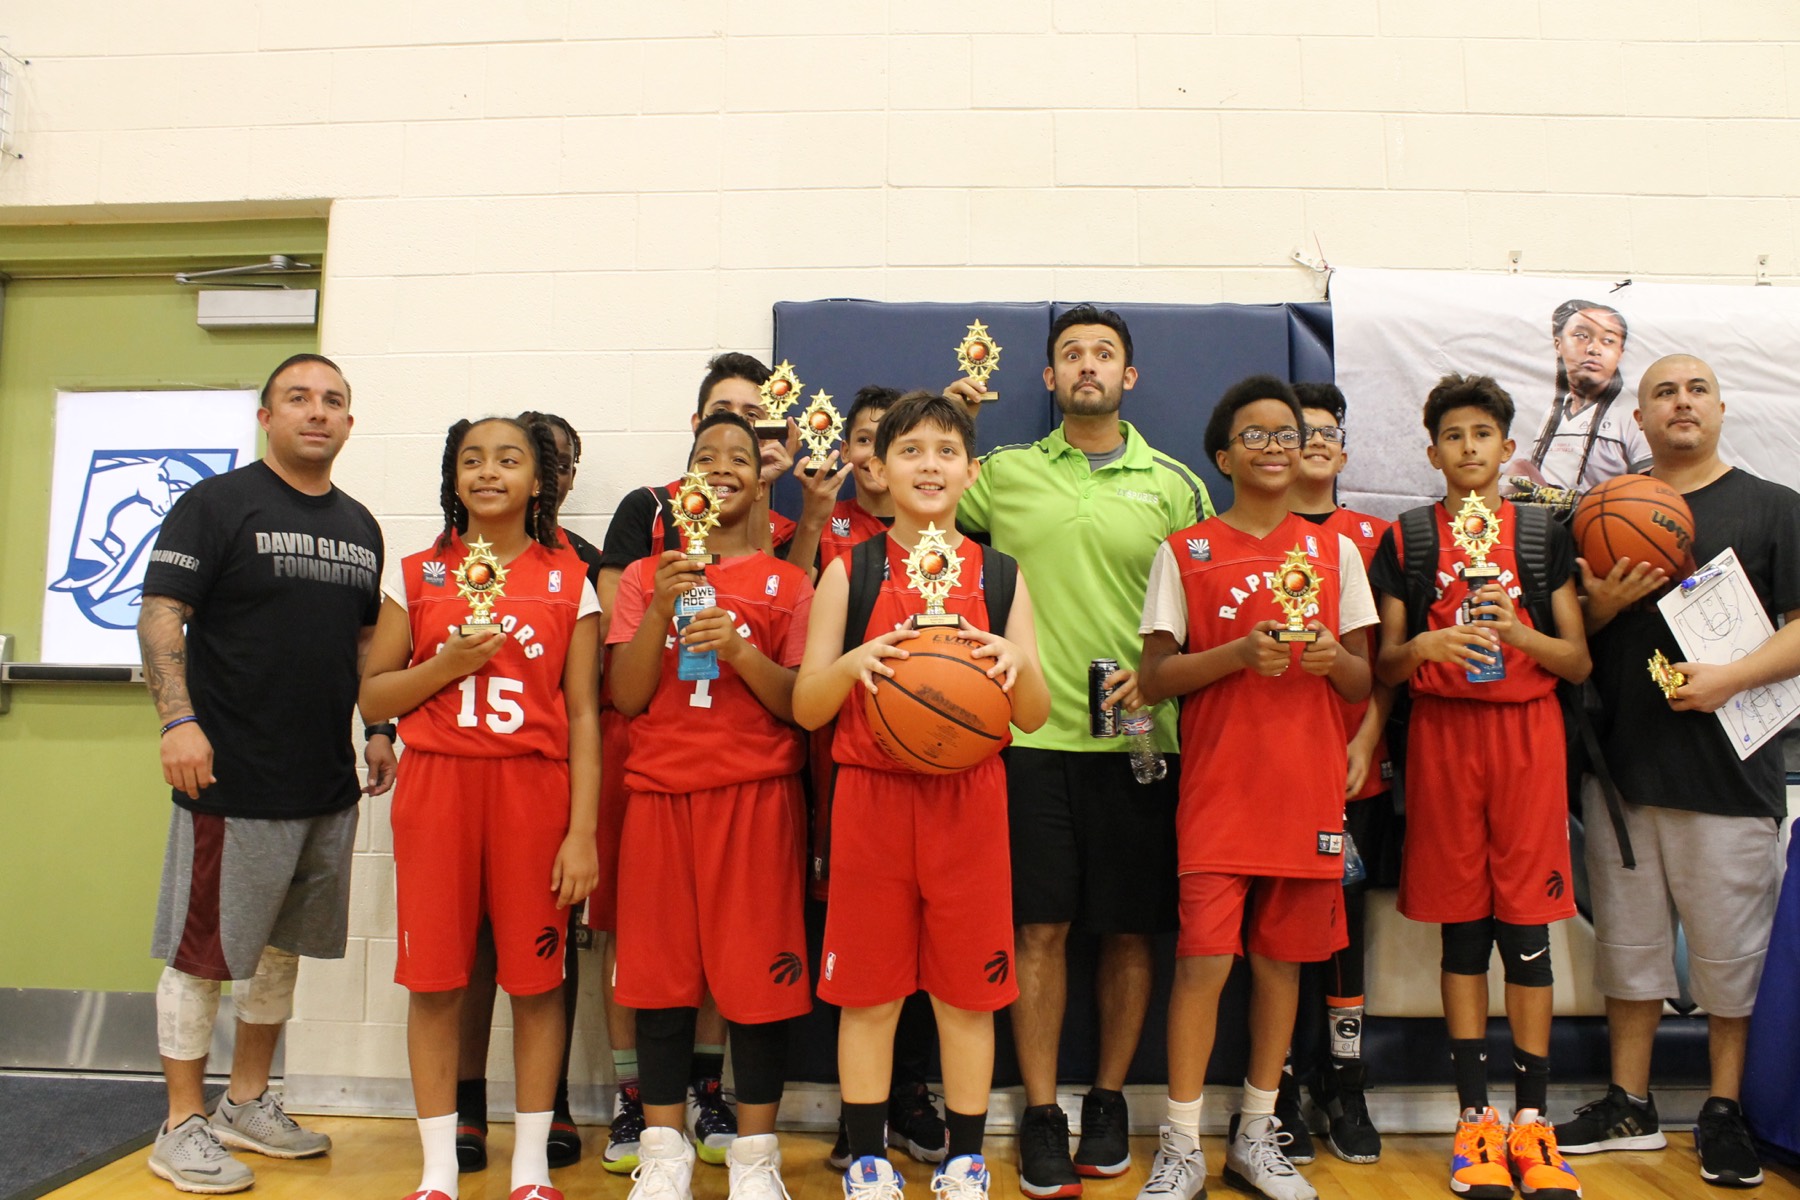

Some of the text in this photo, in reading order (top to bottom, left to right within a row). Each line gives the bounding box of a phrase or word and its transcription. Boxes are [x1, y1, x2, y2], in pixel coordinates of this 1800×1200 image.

[256, 532, 377, 573] DAVID GLASSER
[274, 555, 374, 589] FOUNDATION
[682, 597, 705, 606] ADE
[1218, 571, 1320, 620] RAPTS
[456, 676, 525, 734] 15
